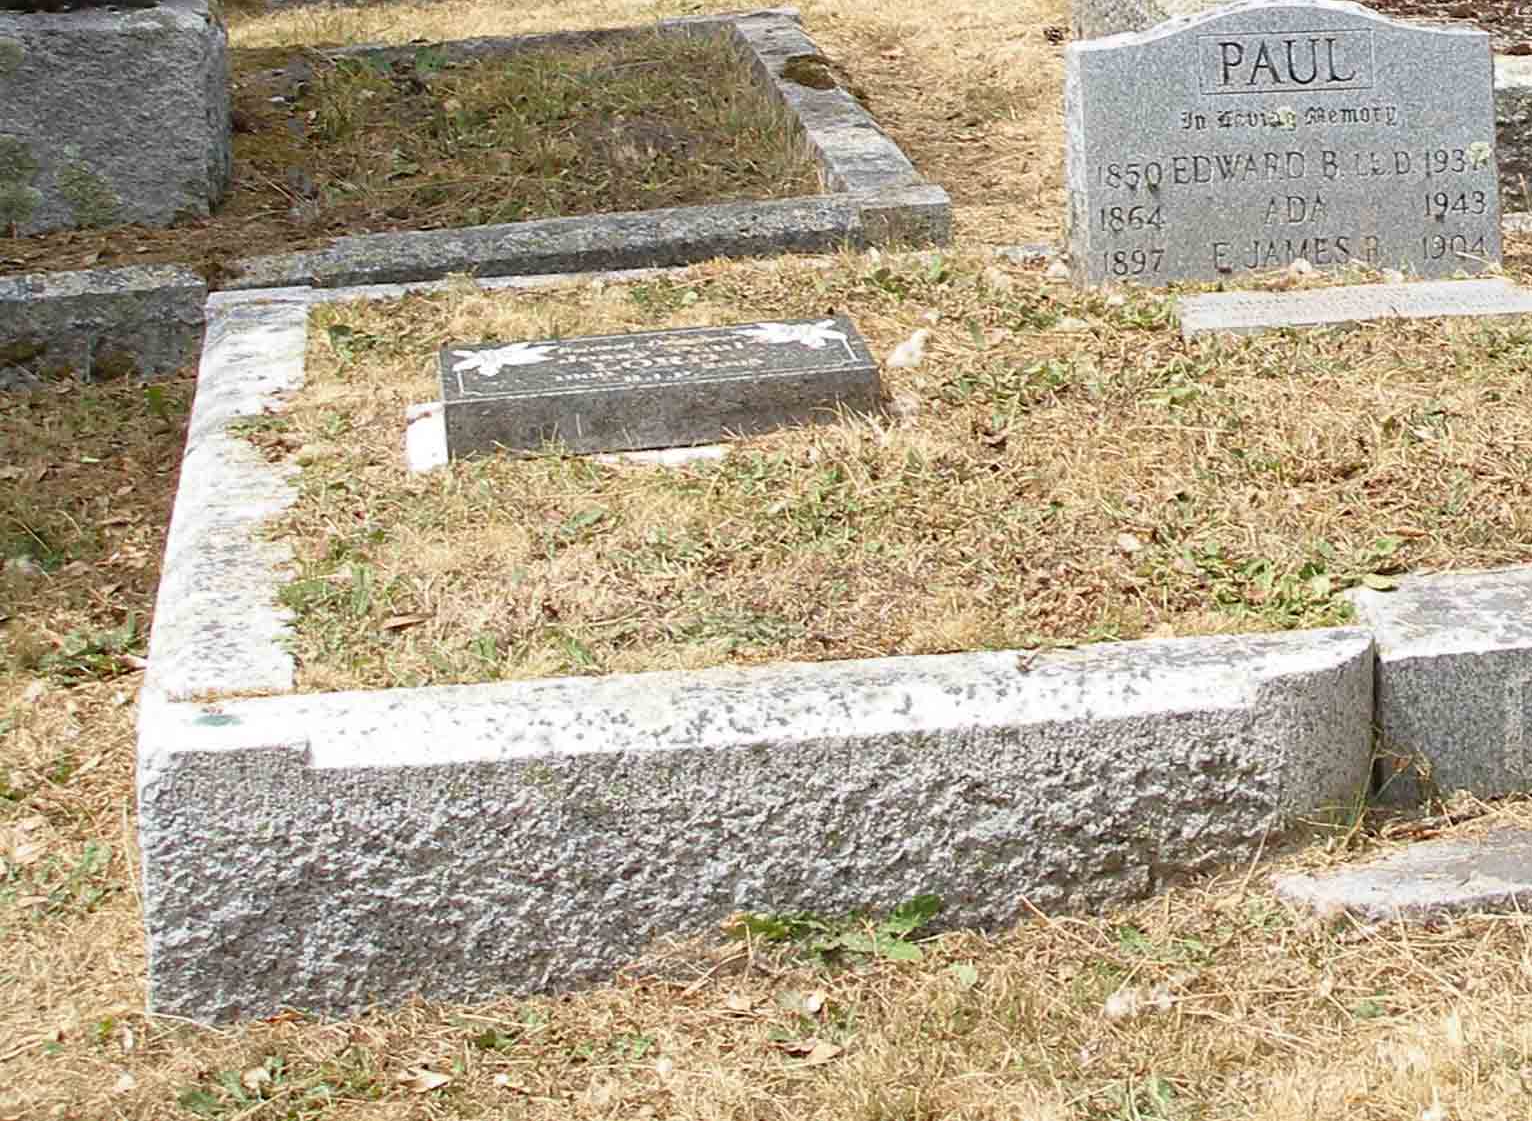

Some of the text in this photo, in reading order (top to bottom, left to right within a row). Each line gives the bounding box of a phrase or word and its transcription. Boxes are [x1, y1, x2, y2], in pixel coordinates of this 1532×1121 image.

[1217, 36, 1358, 88] PAUL
[1180, 110, 1206, 131] In
[1303, 105, 1399, 128] Memory
[1097, 161, 1163, 190] 1850
[1172, 151, 1305, 184] EDWARD
[1099, 190, 1488, 233] 1864 ADA 1943
[1103, 249, 1166, 277] 1897
[1245, 236, 1352, 270] JAMES
[1422, 233, 1488, 261] 1904
